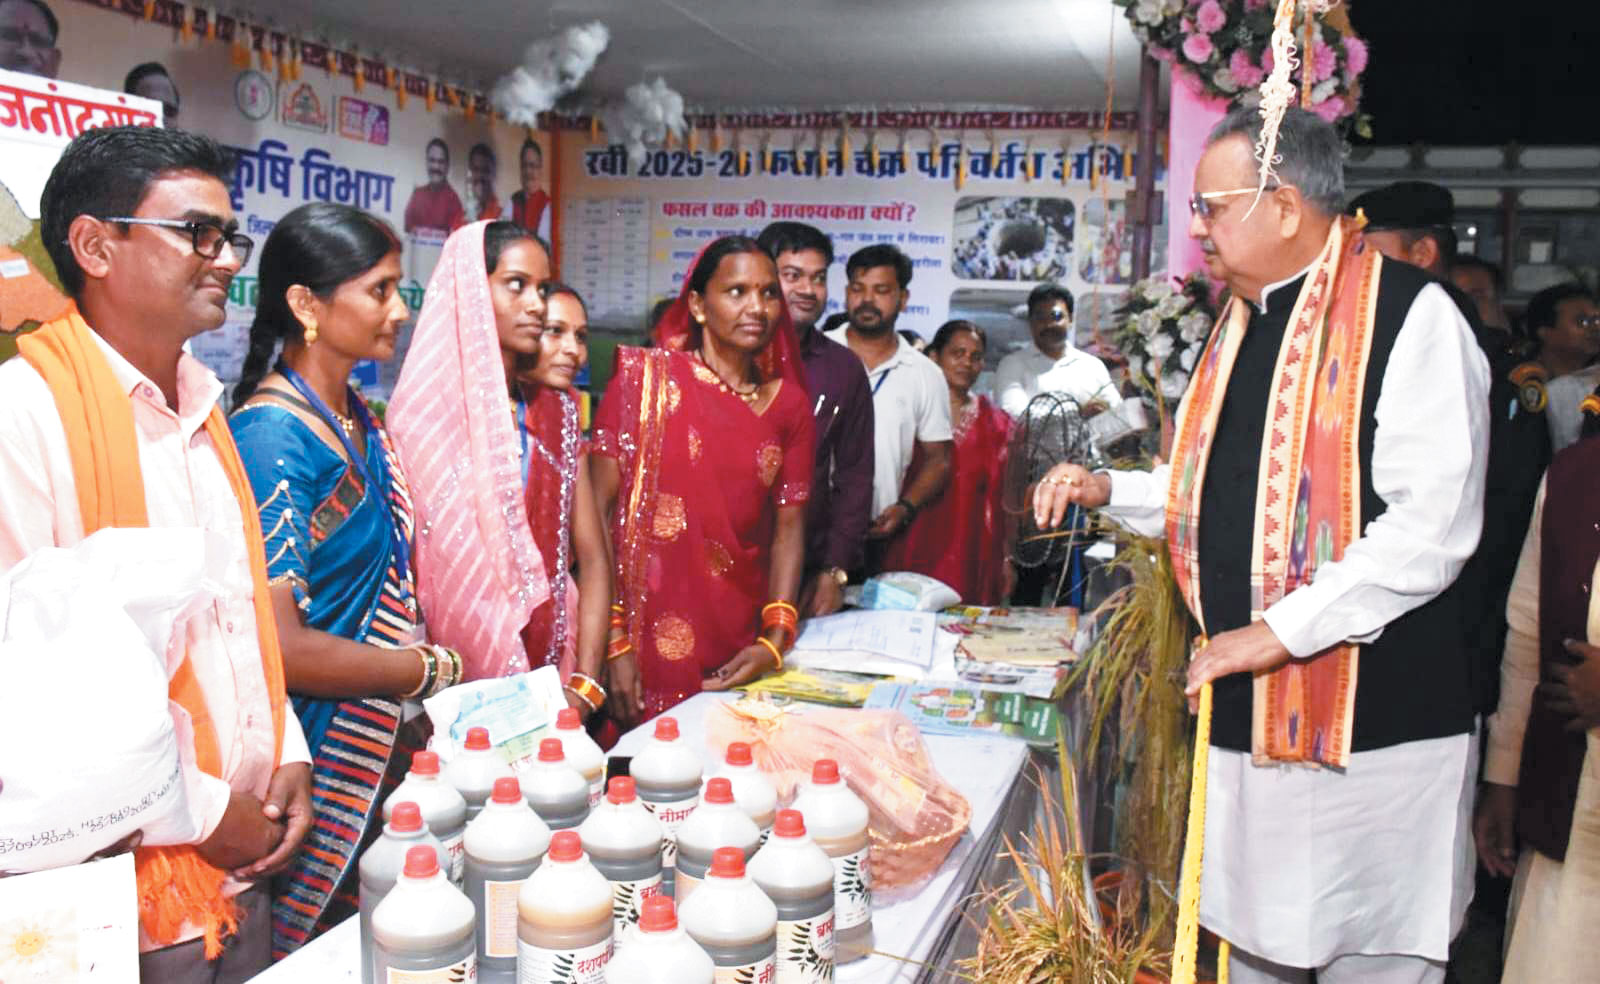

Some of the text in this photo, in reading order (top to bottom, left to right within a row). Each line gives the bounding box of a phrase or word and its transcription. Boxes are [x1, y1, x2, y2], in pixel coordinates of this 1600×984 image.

[638, 150, 752, 177] 2025-26
[301, 148, 395, 213] विभाग
[662, 202, 708, 217] फसल
[712, 202, 739, 217] चक्र
[743, 198, 767, 218] की
[771, 202, 865, 220] आवश्यकता
